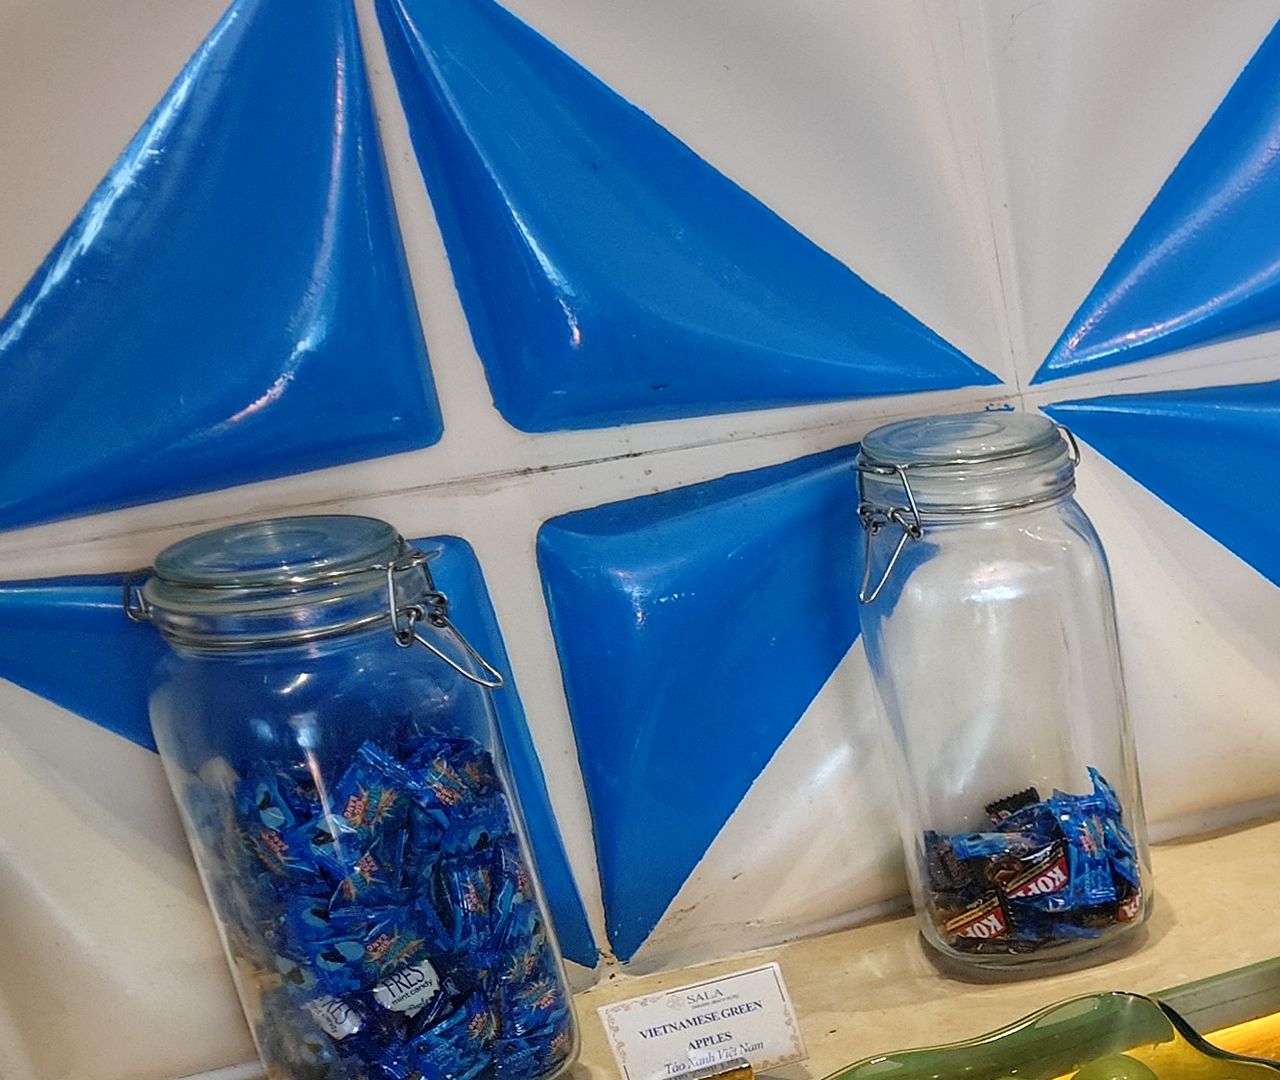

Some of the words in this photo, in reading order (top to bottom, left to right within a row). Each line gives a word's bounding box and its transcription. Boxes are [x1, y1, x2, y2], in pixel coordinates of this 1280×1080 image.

[383, 962, 425, 998] FRES
[391, 992, 411, 1006] mint
[410, 979, 434, 996] candy
[686, 988, 724, 1005] SALA
[639, 1010, 721, 1040] VIETNAMESE
[720, 1000, 763, 1019] GREEN
[687, 1031, 733, 1051] APPLES
[664, 1060, 686, 1075] Táo
[687, 1052, 715, 1070] Xanh
[740, 1041, 764, 1055] Nam
